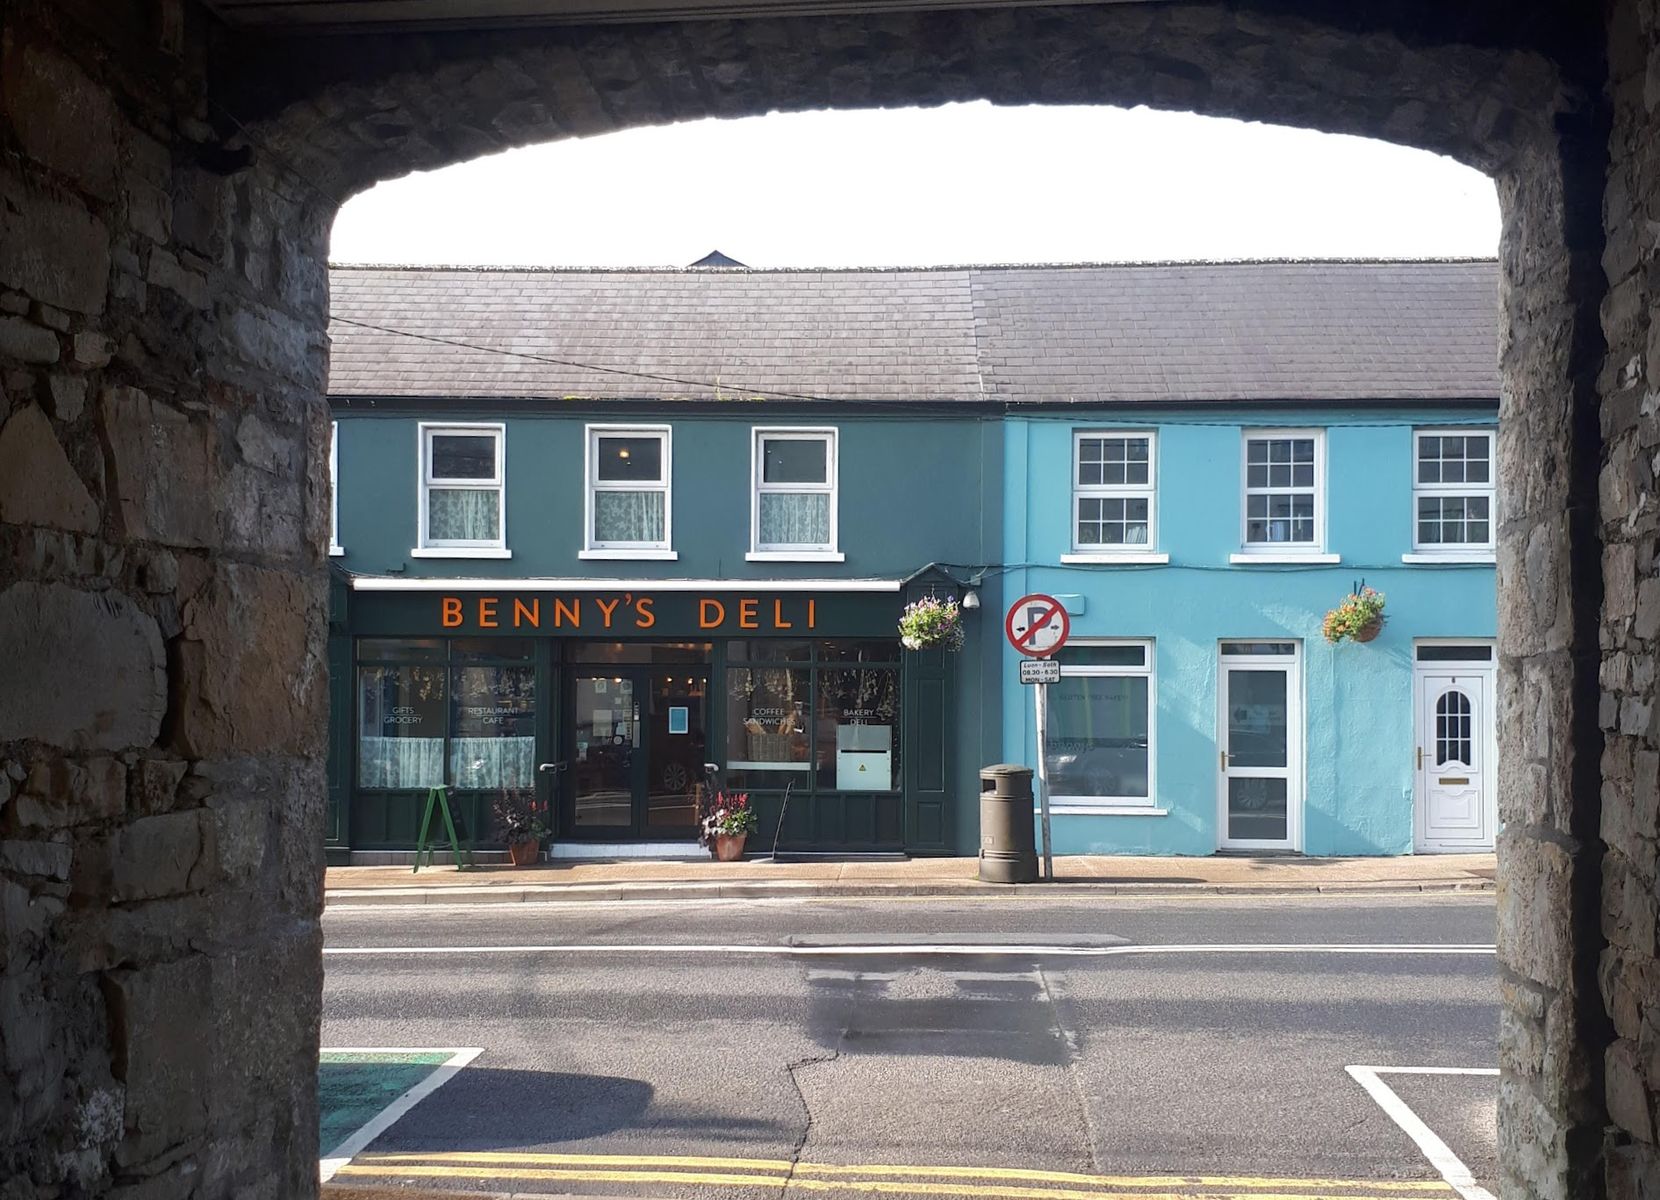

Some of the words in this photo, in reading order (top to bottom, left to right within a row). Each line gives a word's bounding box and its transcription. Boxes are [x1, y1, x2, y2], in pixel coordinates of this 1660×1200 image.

[441, 593, 656, 628] BENNY'S
[699, 599, 815, 629] DELI
[392, 706, 415, 715] GIFTS
[468, 706, 519, 715] RESTAURANT
[753, 707, 785, 716] COFFEE
[843, 708, 874, 717] BAKERY
[383, 716, 423, 725] GROCERY
[482, 716, 504, 725] CAFE
[850, 718, 868, 726] DELI
